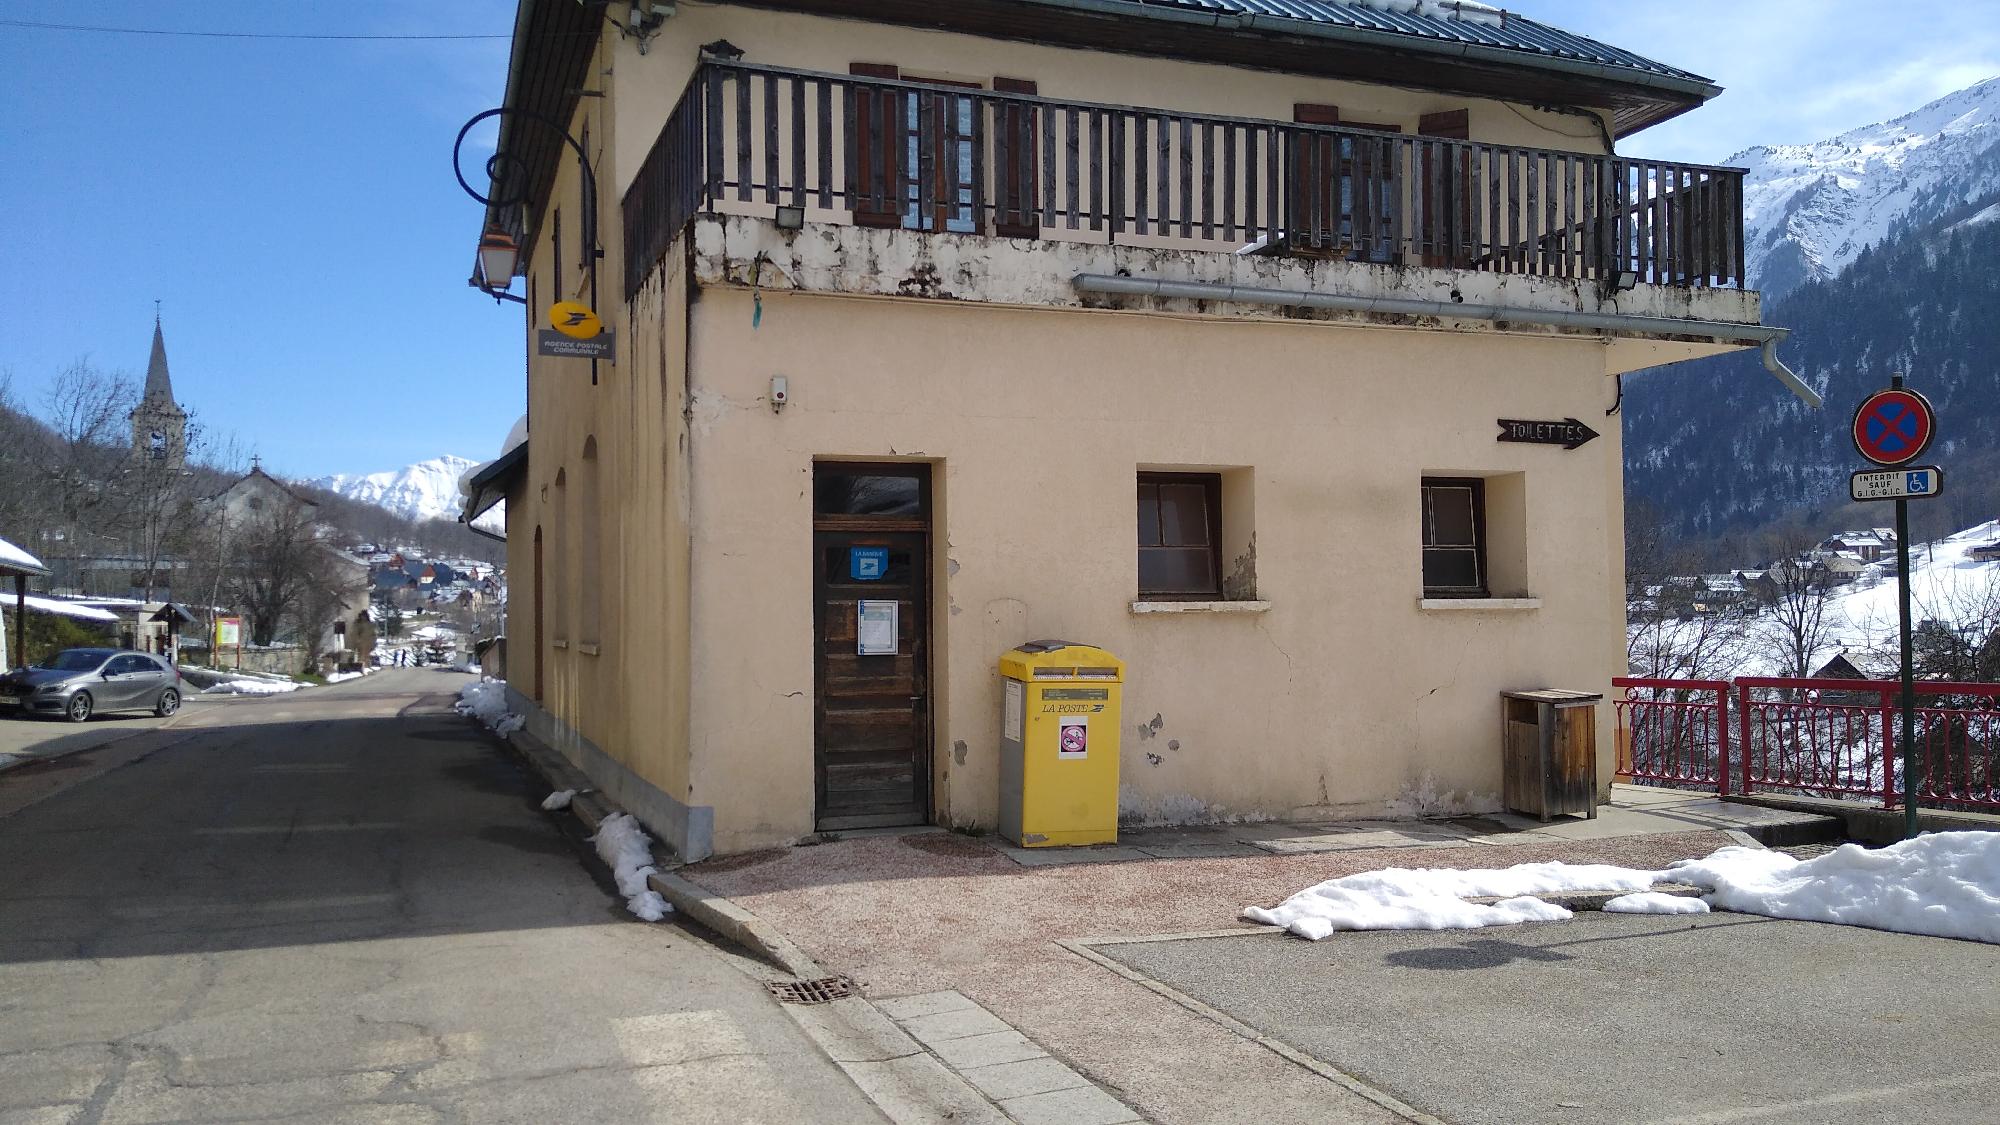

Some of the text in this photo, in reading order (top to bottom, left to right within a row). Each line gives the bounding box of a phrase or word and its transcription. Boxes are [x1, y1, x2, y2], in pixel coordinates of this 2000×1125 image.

[576, 342, 608, 350] POSTALE
[1509, 423, 1584, 440] TOILETTES
[1859, 472, 1900, 482] INTERDIT
[1868, 481, 1892, 489] SAUF
[1042, 704, 1089, 713] LA POSTE
